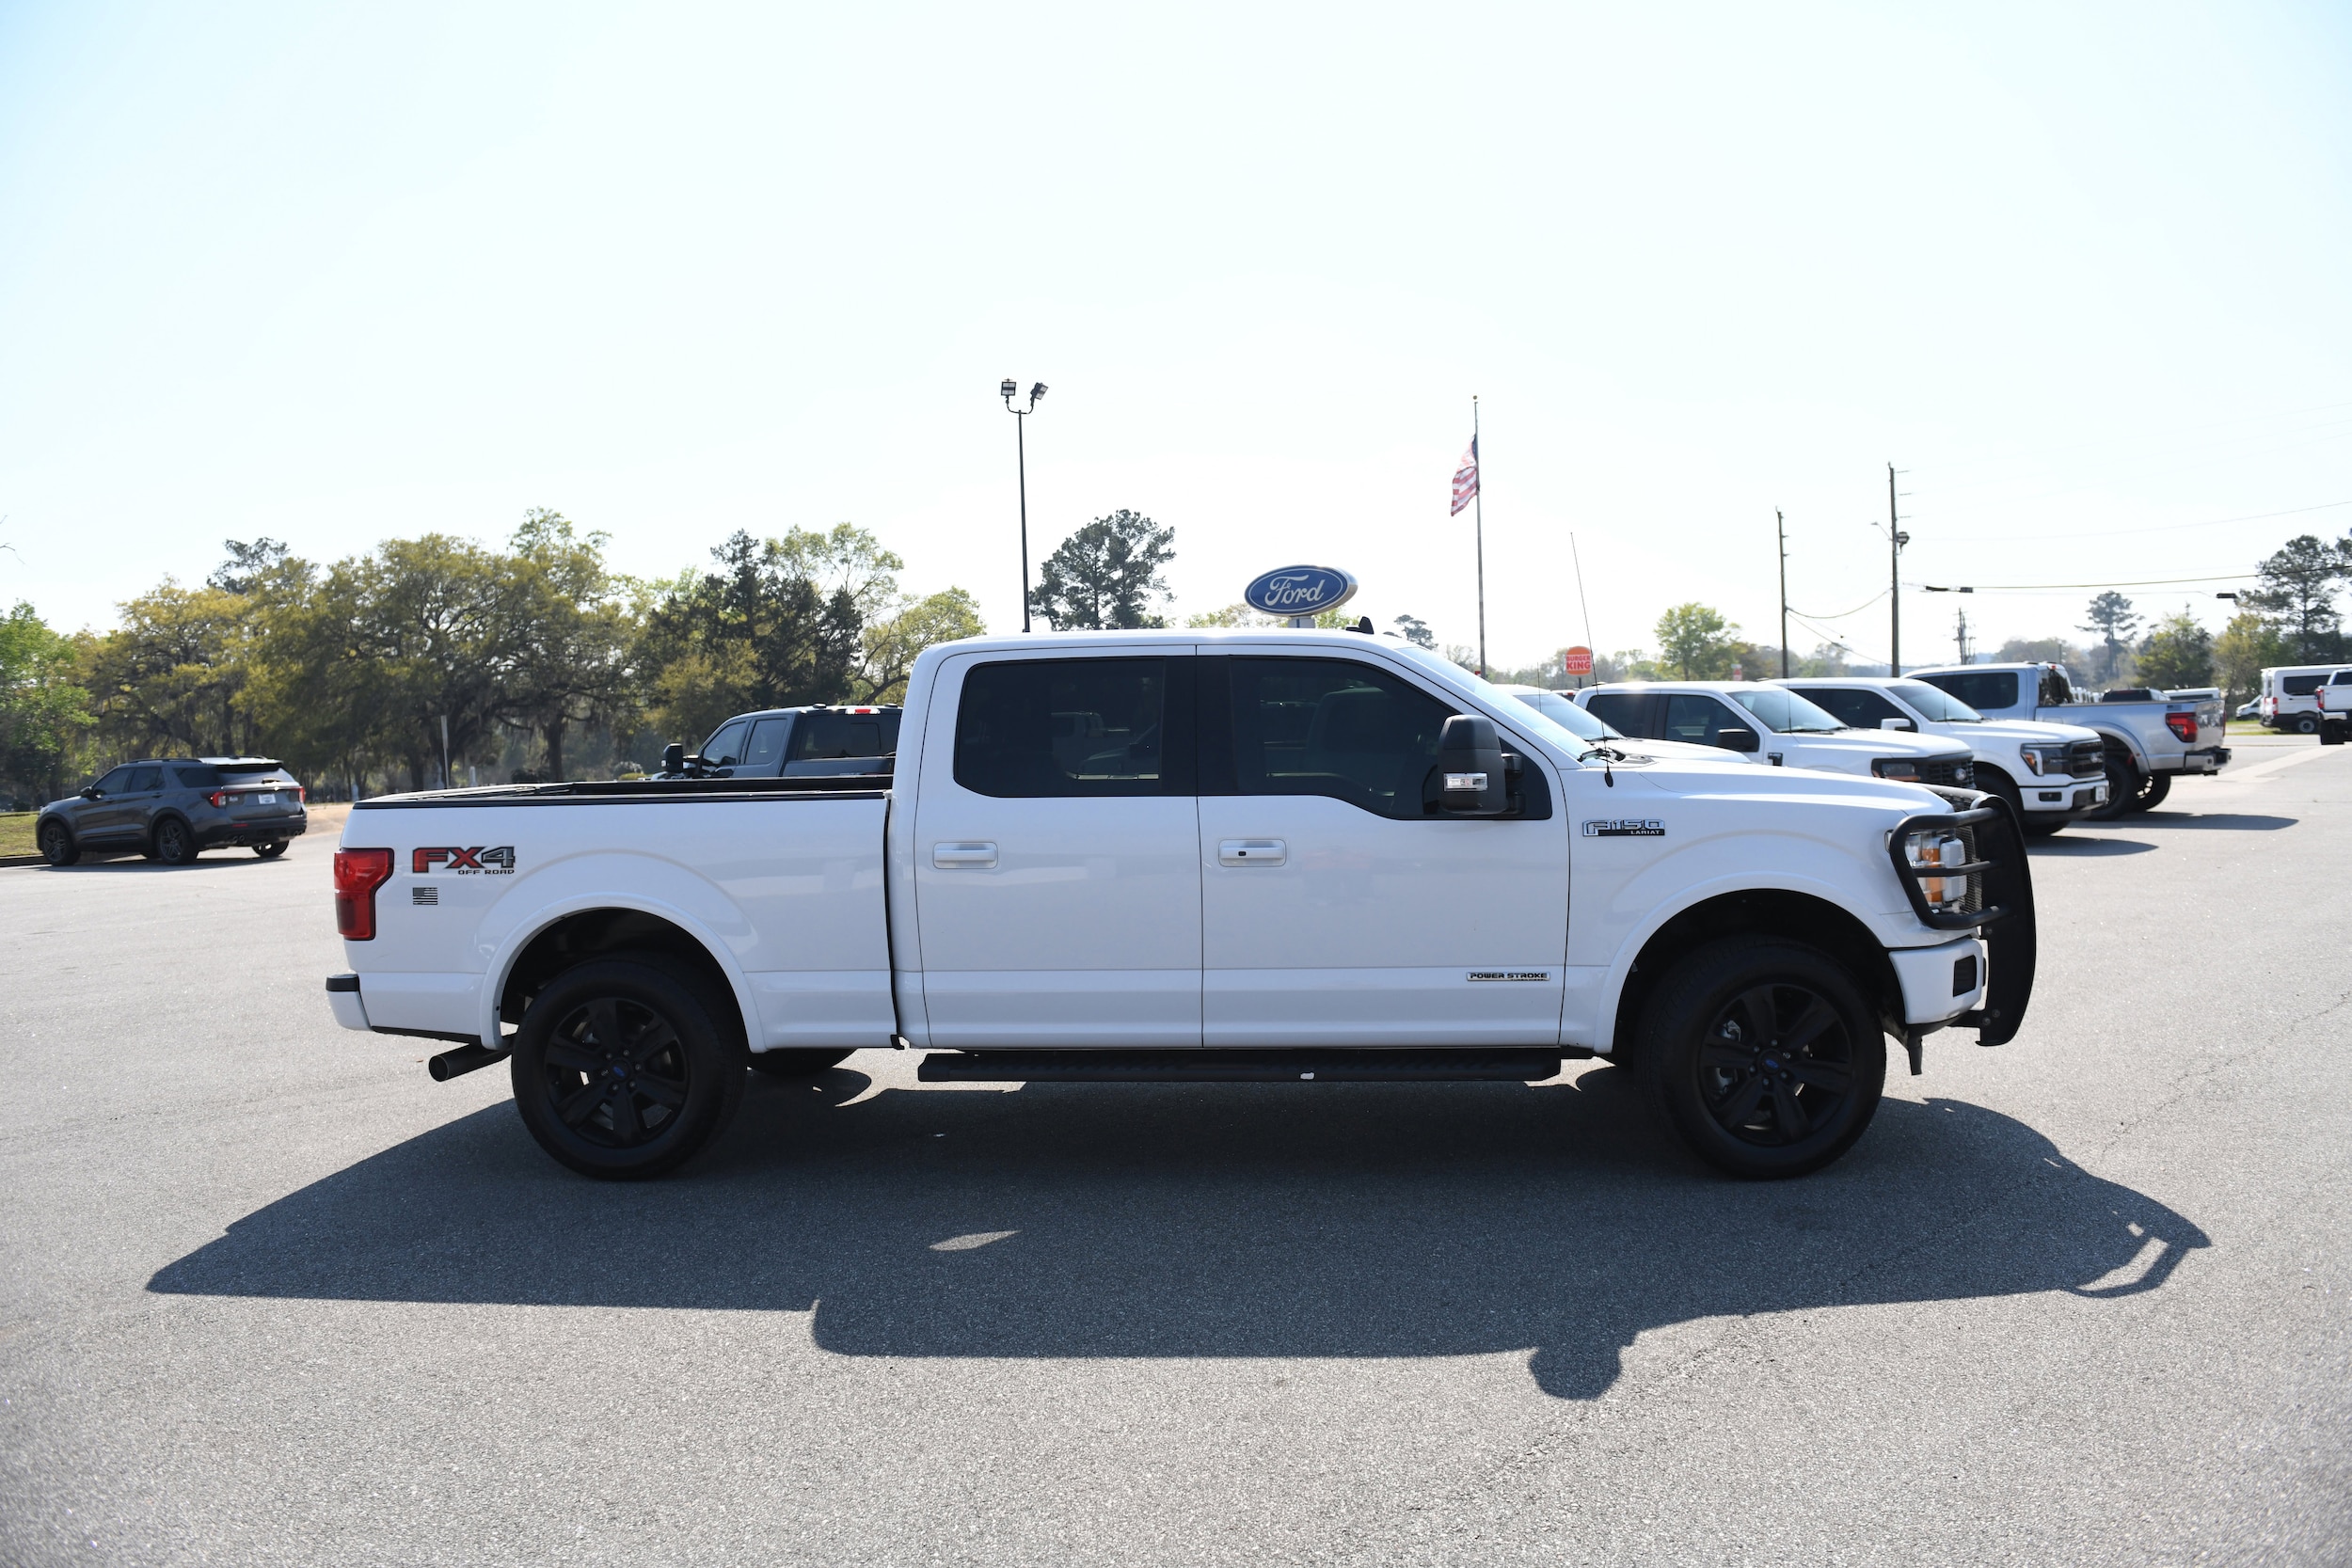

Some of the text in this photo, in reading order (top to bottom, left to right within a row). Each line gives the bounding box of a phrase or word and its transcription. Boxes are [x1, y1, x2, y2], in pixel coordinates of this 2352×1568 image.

[1264, 575, 1325, 606] Ford
[1566, 661, 1591, 670] KING
[412, 846, 516, 873] FX4
